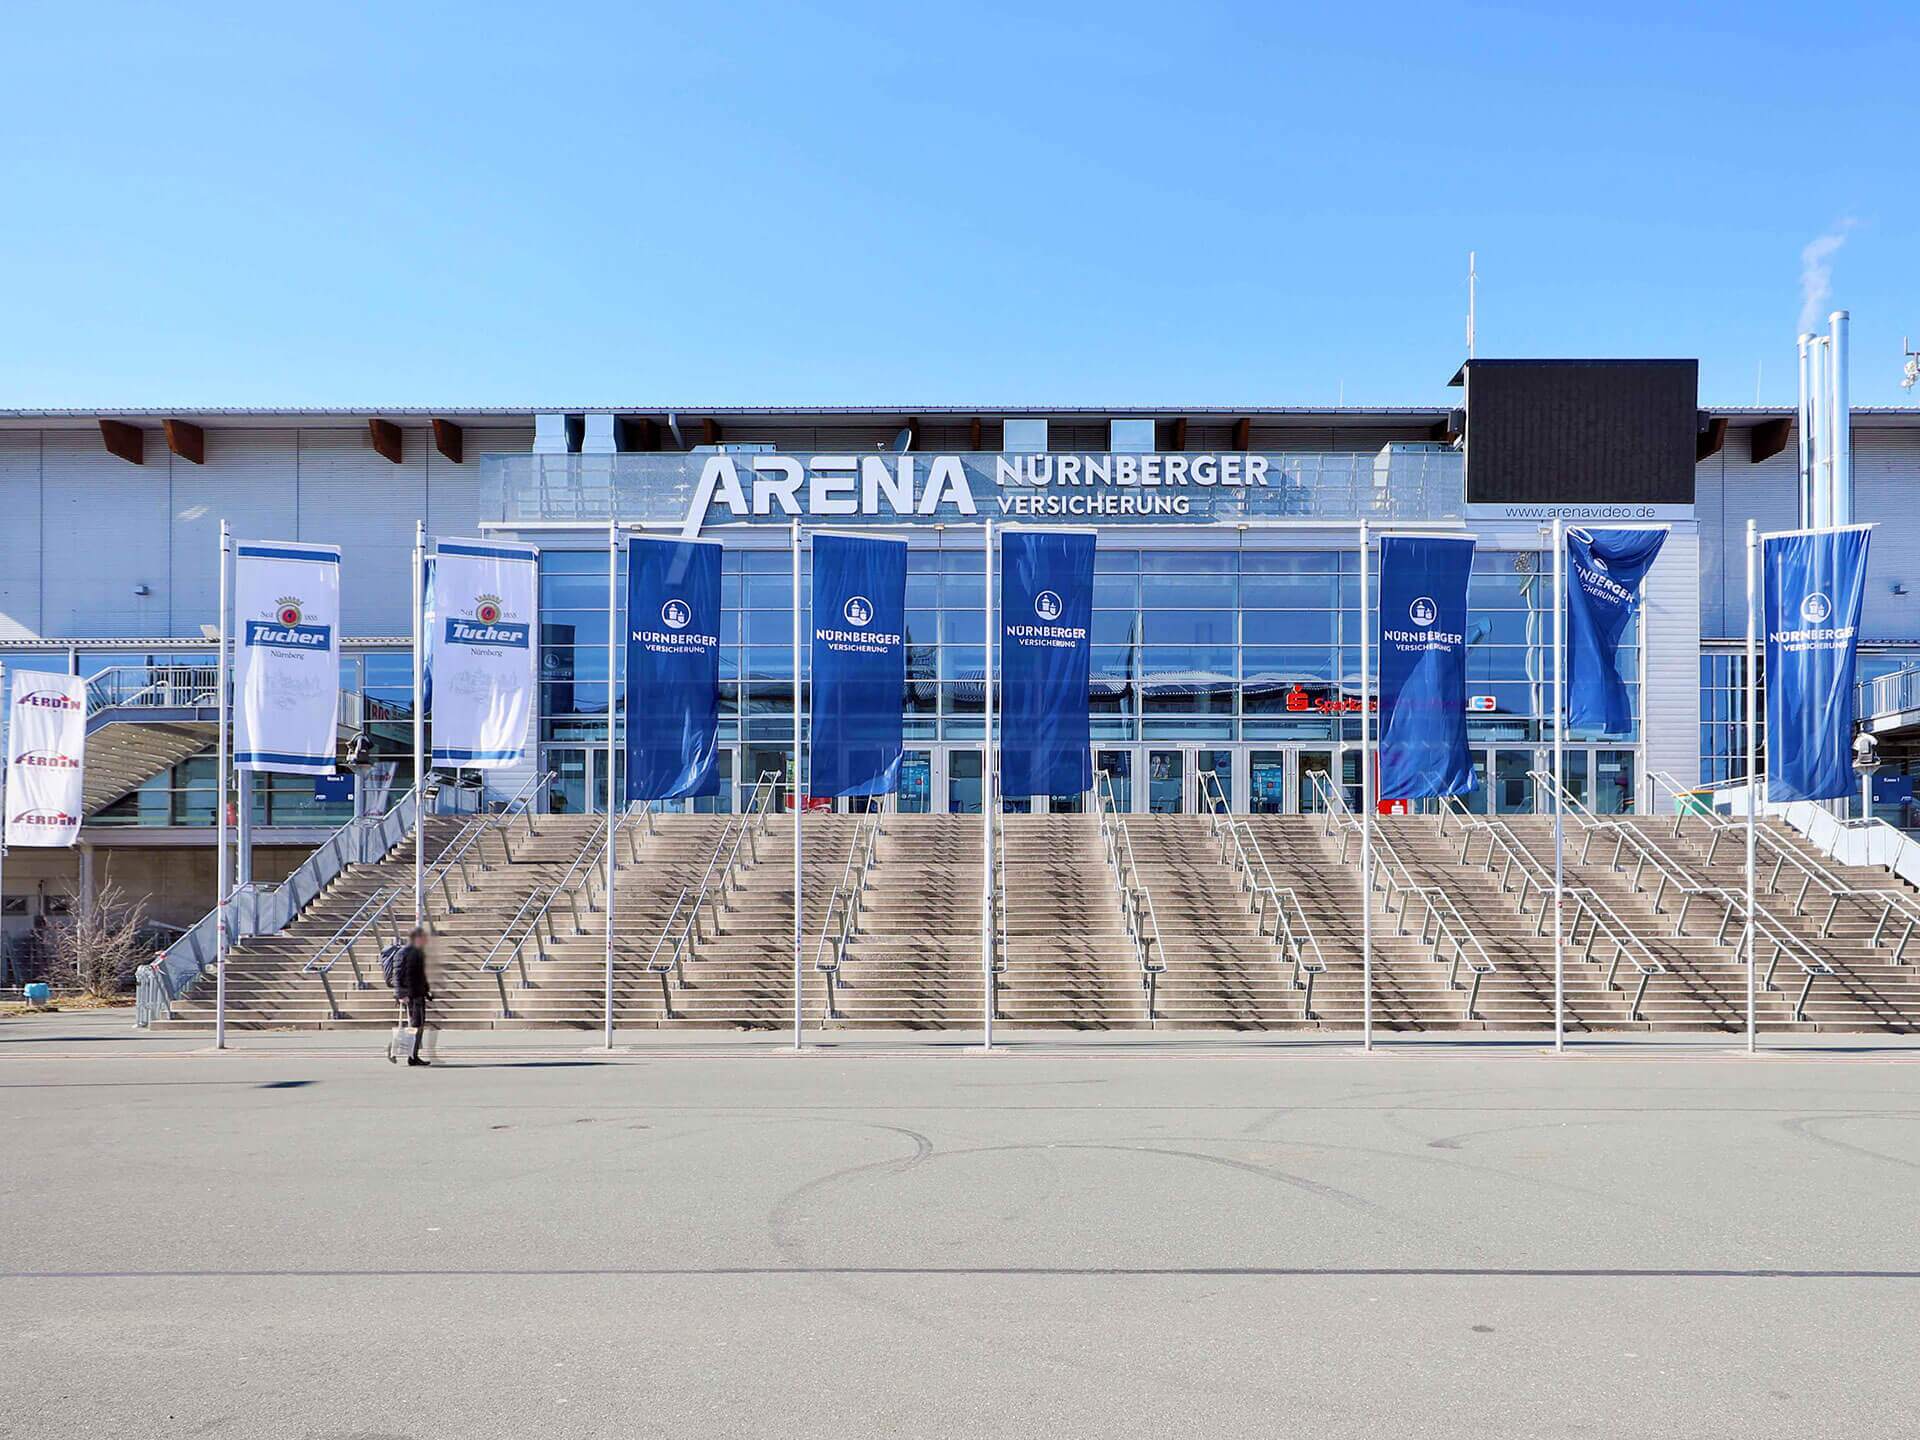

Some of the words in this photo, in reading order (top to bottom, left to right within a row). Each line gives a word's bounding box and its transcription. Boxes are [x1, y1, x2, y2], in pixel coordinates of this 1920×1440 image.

[996, 454, 1270, 486] NÜRNBERGER
[682, 456, 977, 536] ARENA
[999, 495, 1190, 515] VERSICHERUNG
[1505, 505, 1656, 519] www.arenavideo.de
[253, 626, 325, 645] Tucher
[453, 623, 524, 642] Tucher
[632, 631, 717, 647] NÜRNBERGER
[816, 628, 901, 645] NÜRNBERGER
[1006, 625, 1087, 640] NÜRNBERGER
[1384, 630, 1463, 645] NÜRNBERGER
[645, 644, 705, 654] VERSICHERUNG
[828, 642, 889, 654] VERSICHERUNG
[1019, 638, 1077, 648] VERSICHERUNG
[1396, 643, 1452, 653] VERSICHERUNG
